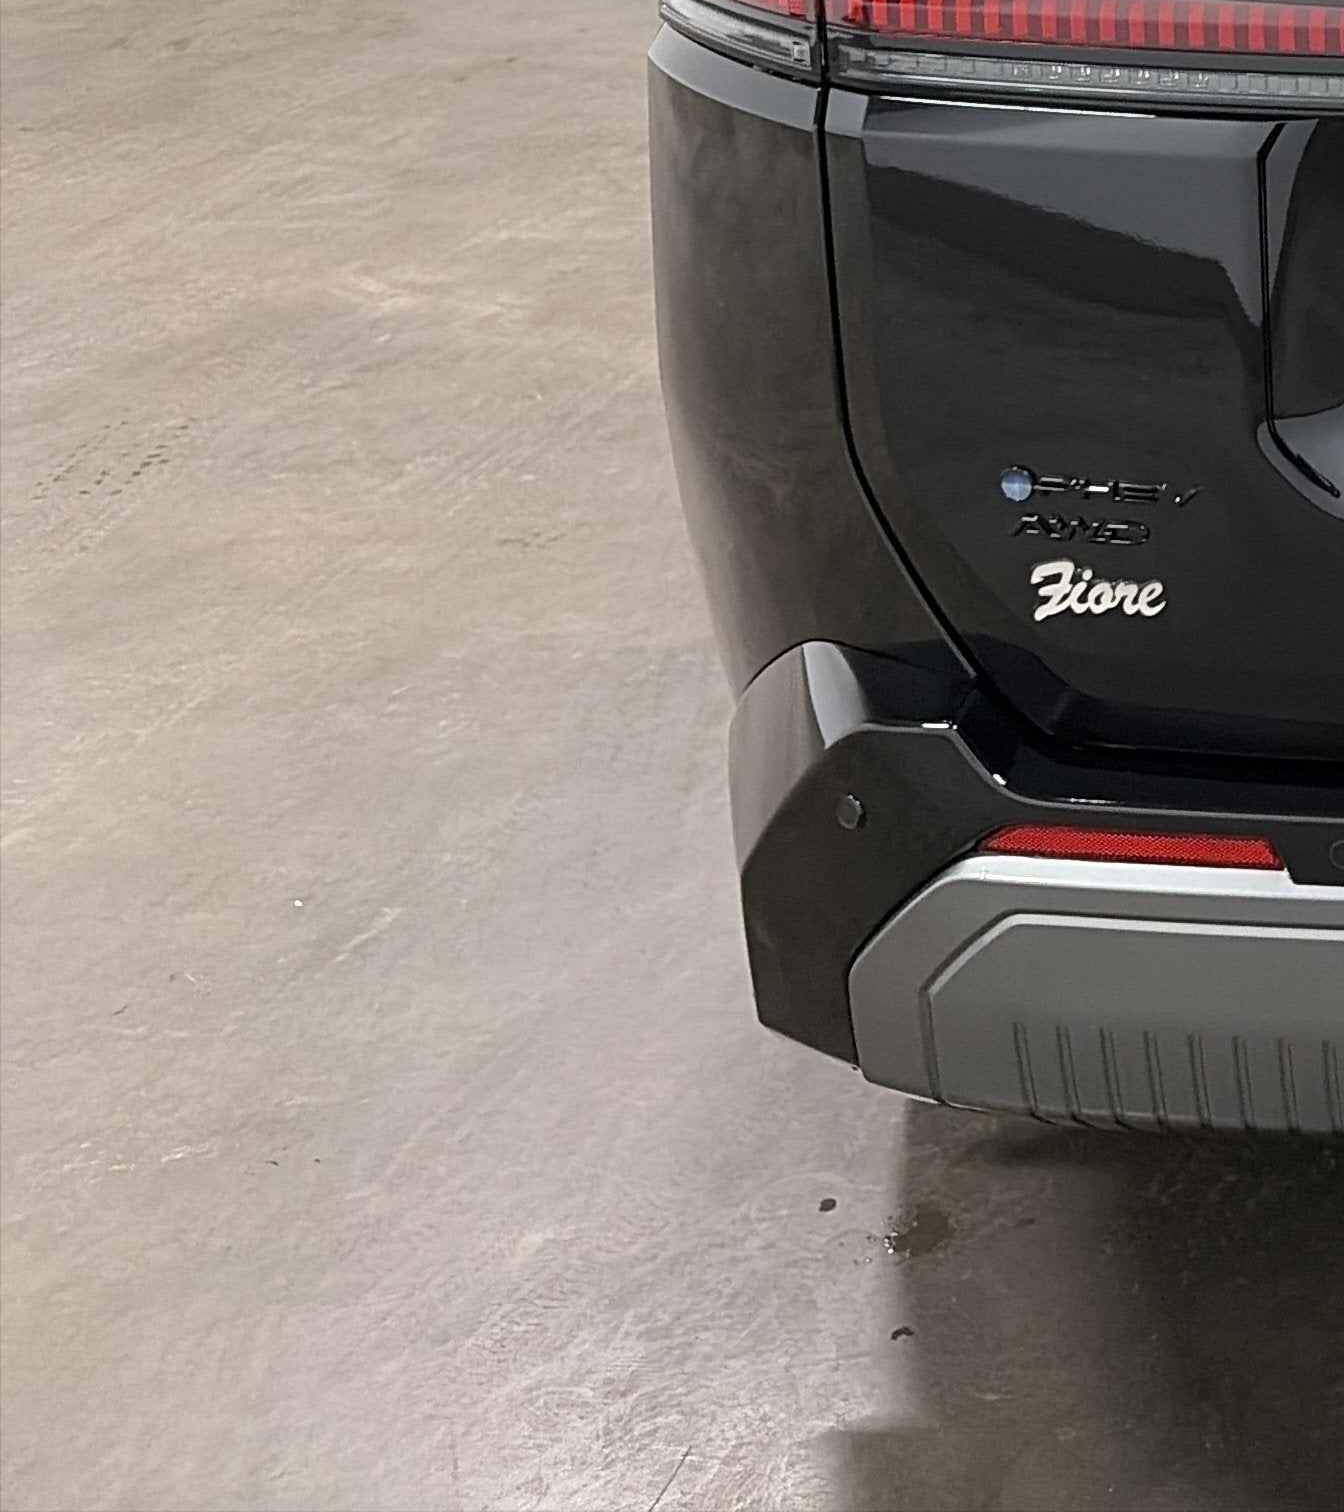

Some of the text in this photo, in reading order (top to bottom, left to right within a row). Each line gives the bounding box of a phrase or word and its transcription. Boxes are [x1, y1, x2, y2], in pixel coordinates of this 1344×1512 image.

[1033, 474, 1205, 507] PHEV
[1009, 512, 1151, 545] AWD
[1030, 557, 1167, 623] Fiore
